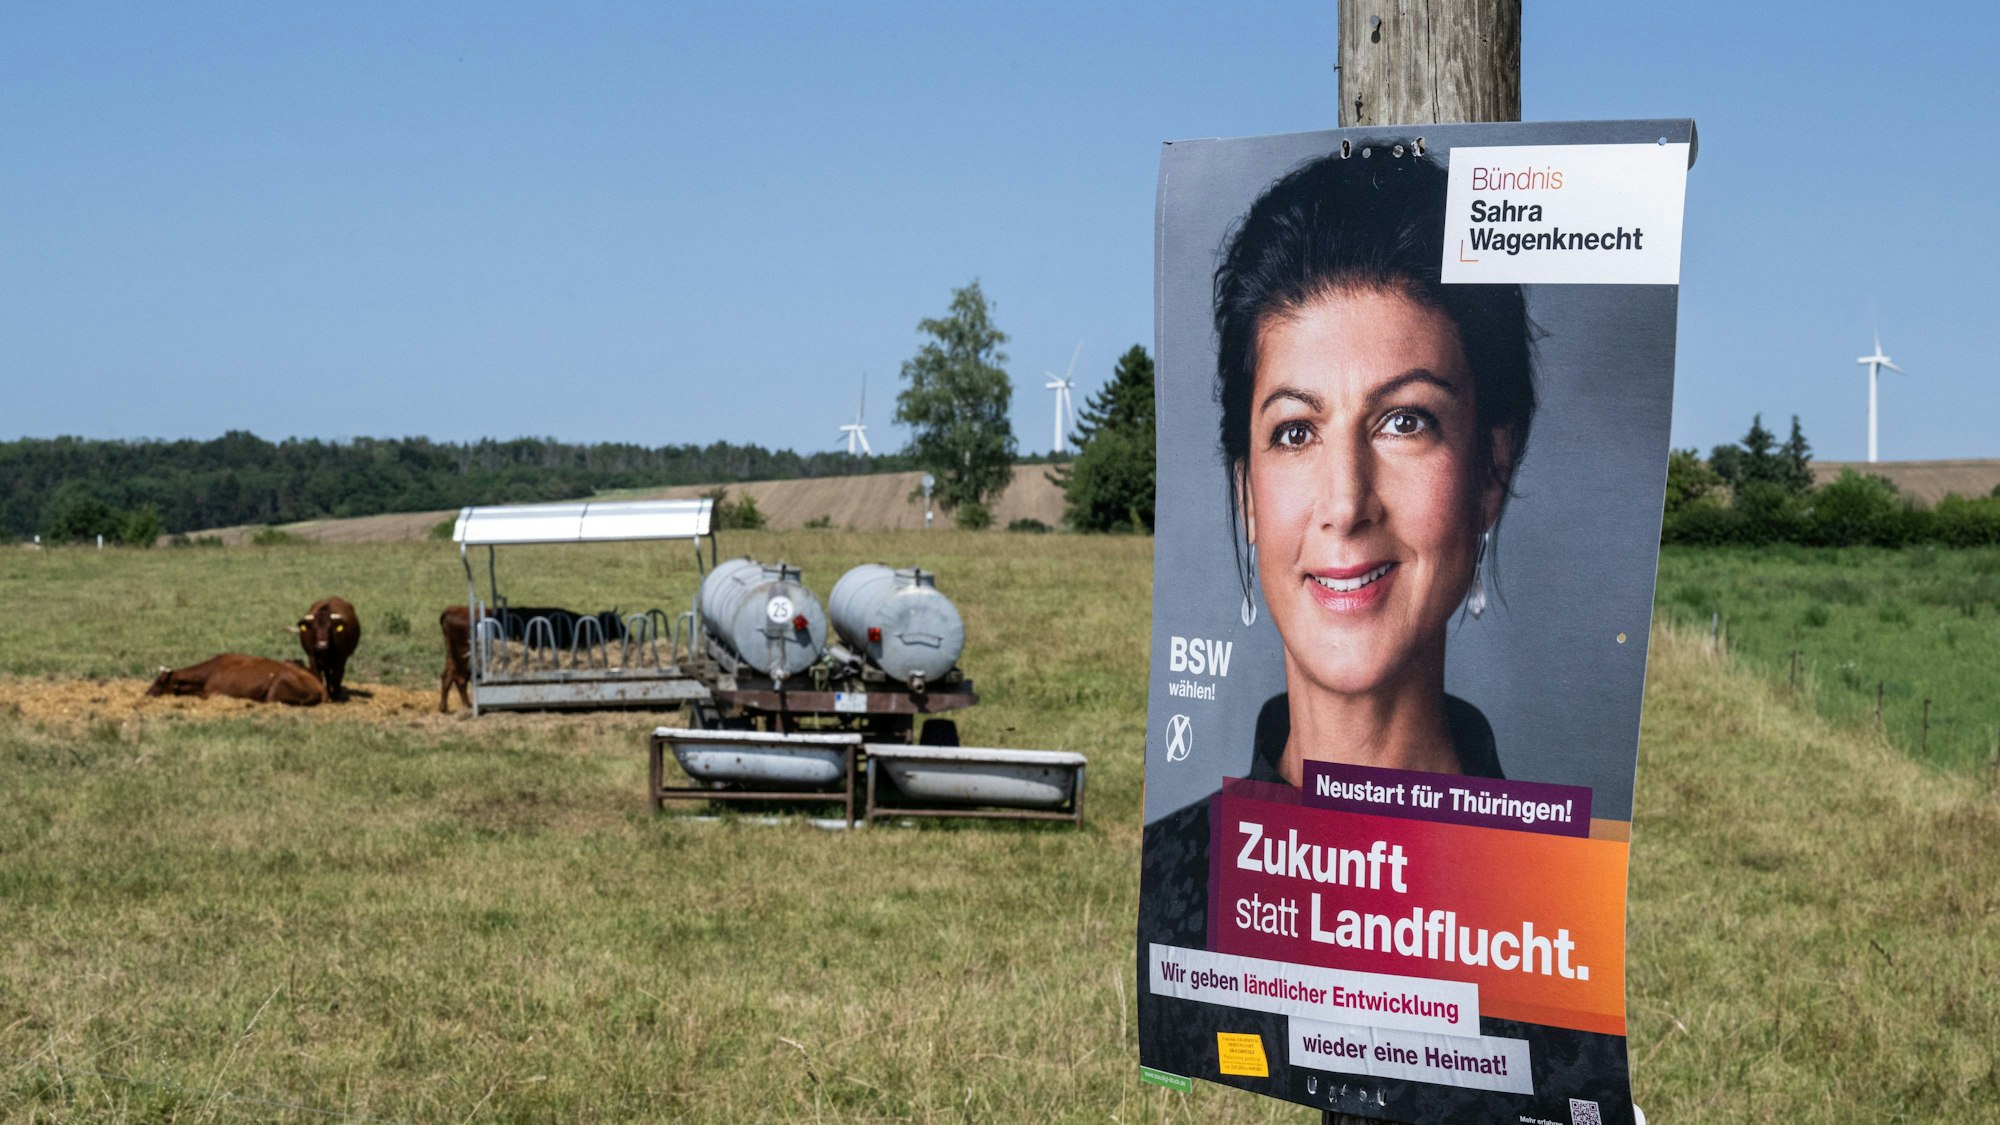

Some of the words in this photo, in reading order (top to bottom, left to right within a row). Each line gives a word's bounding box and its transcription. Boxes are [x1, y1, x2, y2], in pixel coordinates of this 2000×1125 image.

[1472, 166, 1564, 191] Bündnis
[1470, 199, 1543, 223] Sahra
[1469, 227, 1644, 256] Wagenknecht
[773, 601, 789, 618] 25
[1169, 636, 1233, 677] BSW
[1168, 680, 1216, 700] wählen!
[1316, 773, 1404, 806] Neustart
[1411, 784, 1443, 809] für
[1449, 788, 1573, 824] Thüringen!
[1236, 820, 1408, 894] Zukunft
[1235, 892, 1299, 939] statt
[1310, 892, 1590, 981] Landflucht.
[1161, 960, 1186, 984] Wir
[1191, 965, 1239, 992] geben
[1243, 972, 1327, 1005] ländlicher
[1332, 985, 1459, 1024] Entwicklung
[1302, 1033, 1367, 1060] wieder
[1374, 1041, 1418, 1065] eine
[1424, 1046, 1507, 1077] Heimat!
[1519, 1115, 1536, 1124] Mehr
